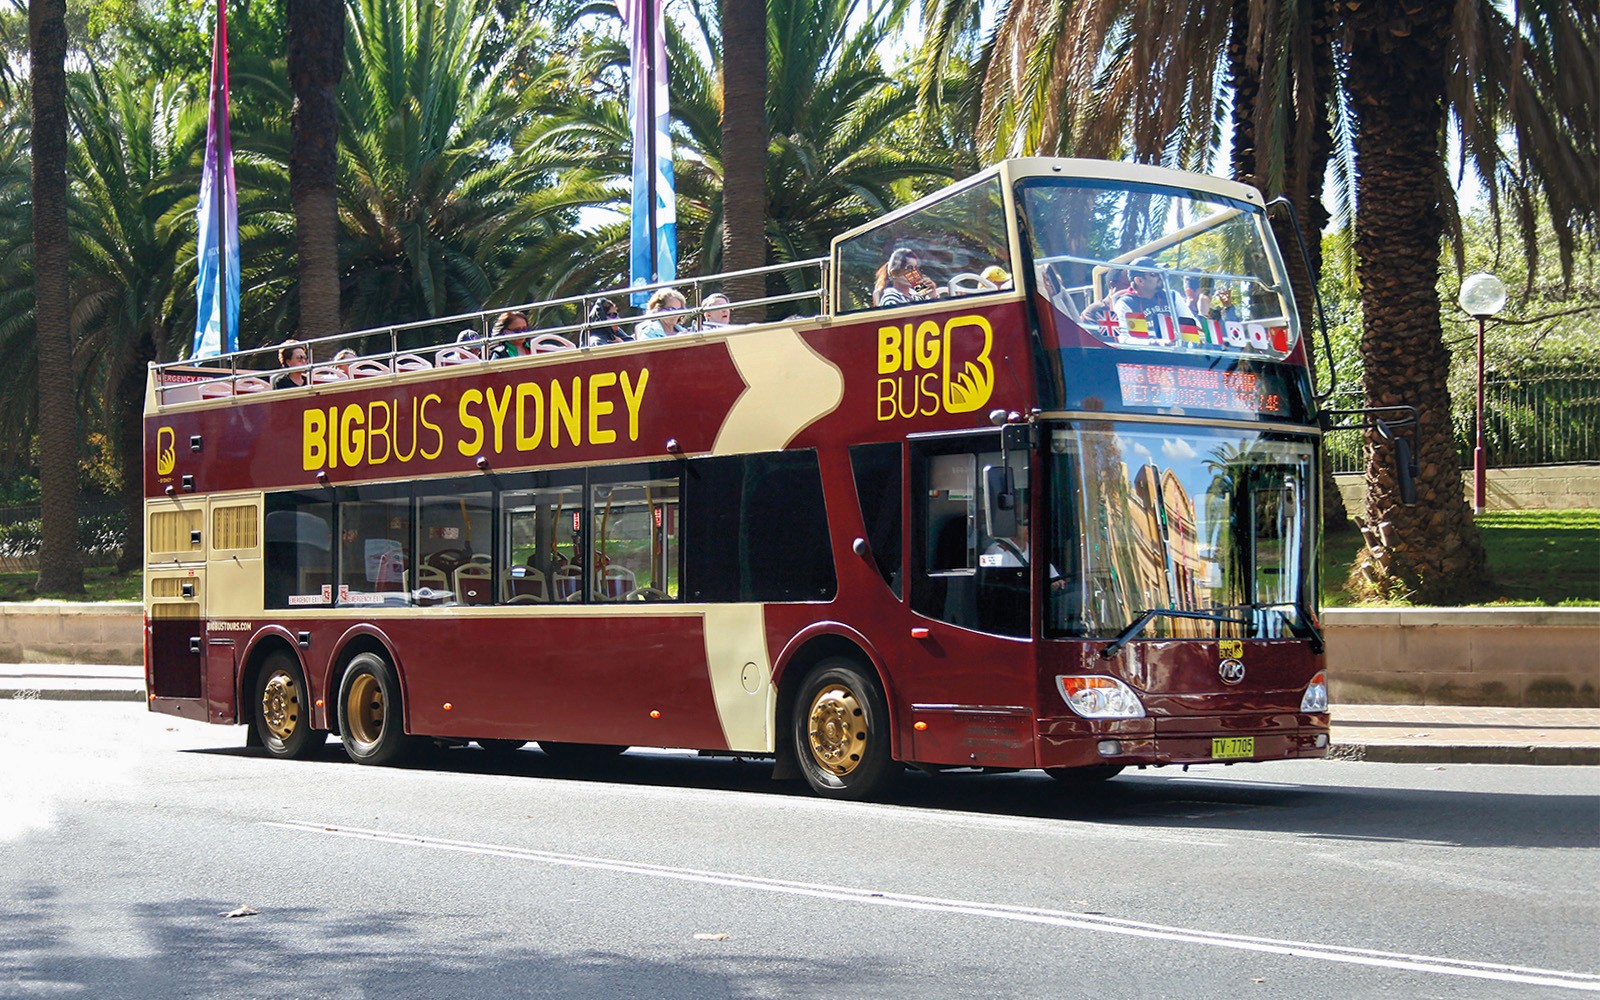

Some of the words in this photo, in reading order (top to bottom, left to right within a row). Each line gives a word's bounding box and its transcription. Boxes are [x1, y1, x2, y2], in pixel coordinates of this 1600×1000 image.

[878, 320, 941, 375] BIG
[302, 393, 444, 472] BIGBUS
[457, 367, 650, 457] SYDNEY
[877, 372, 940, 421] BUS
[1218, 640, 1232, 649] BIG
